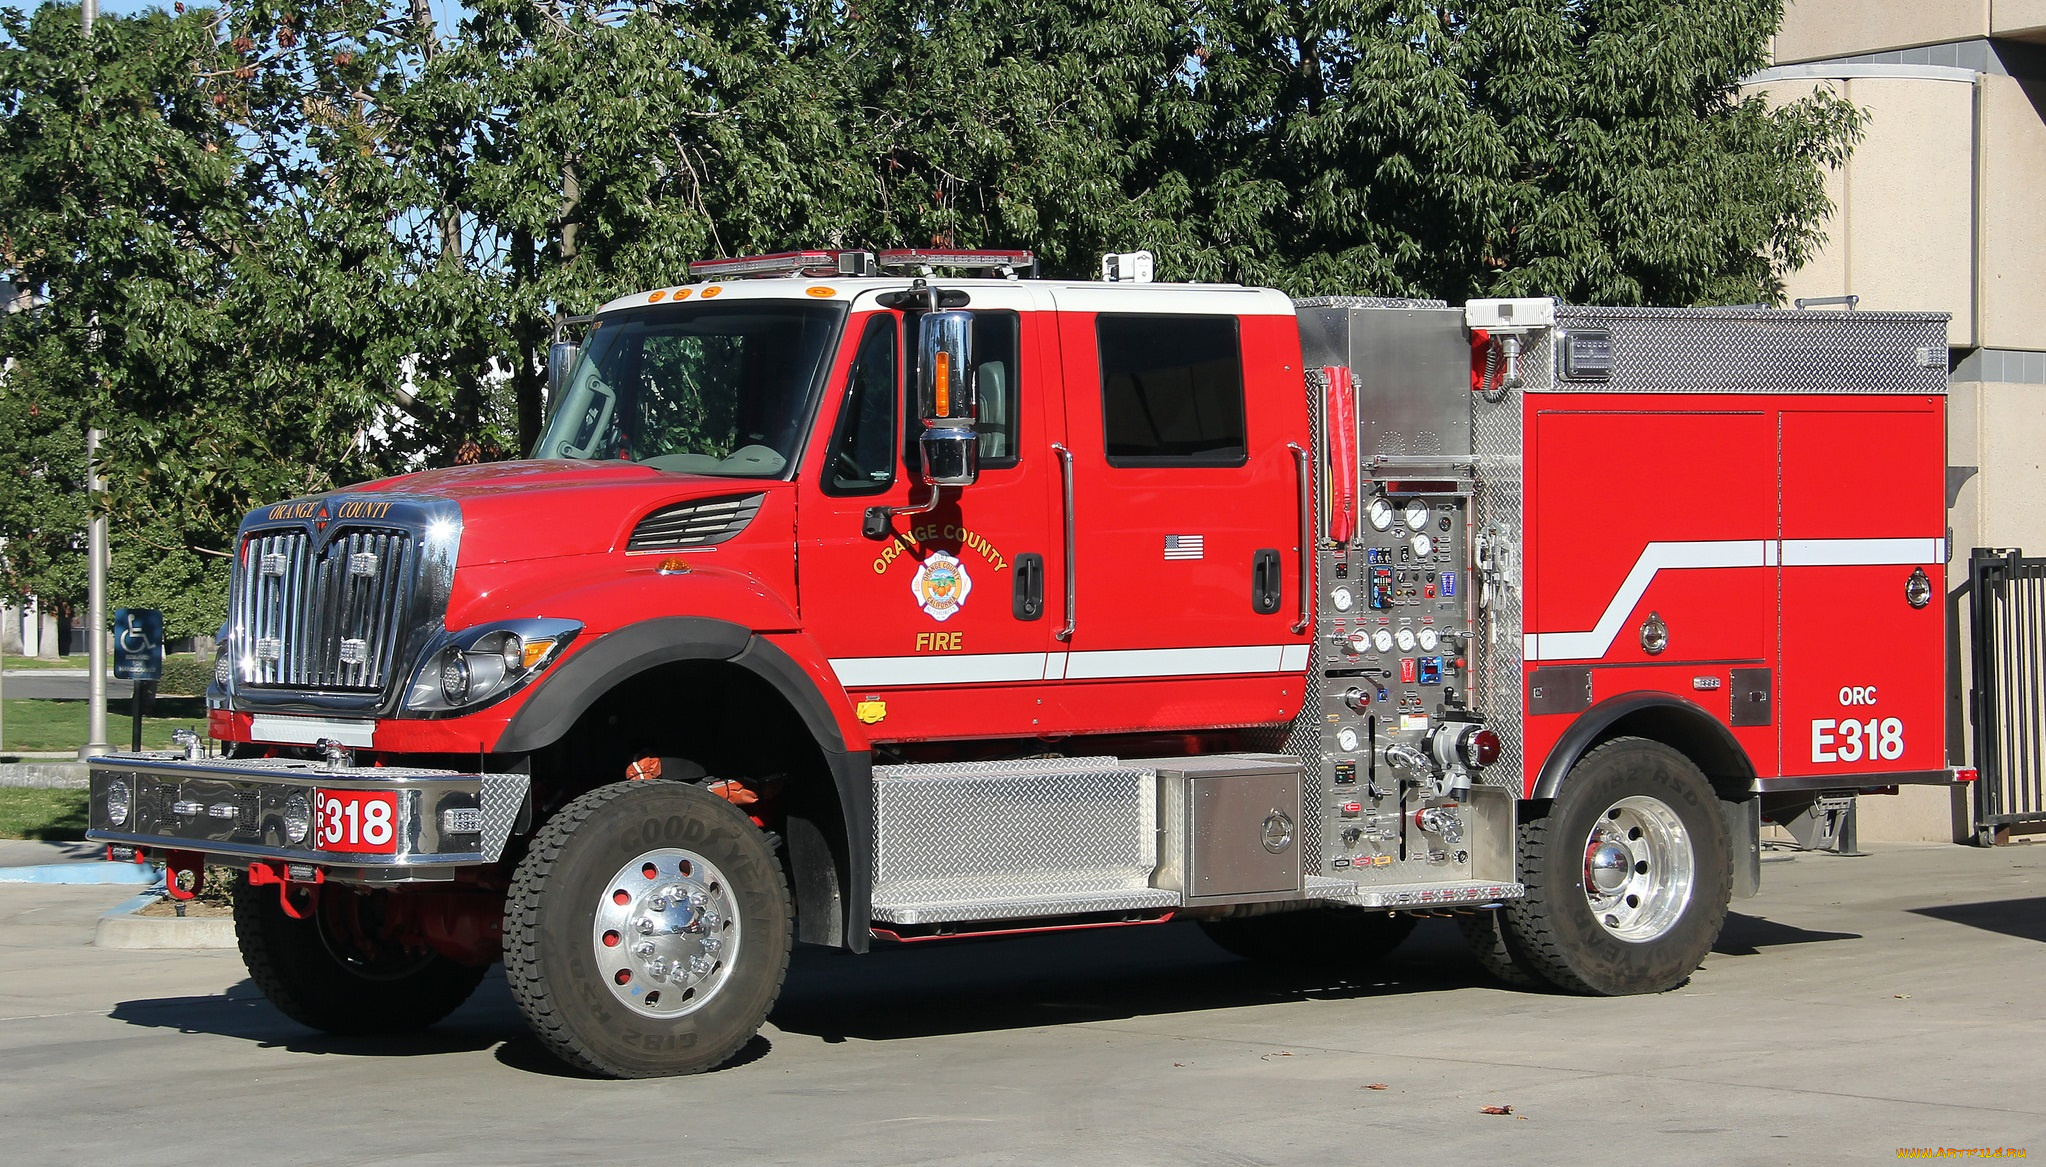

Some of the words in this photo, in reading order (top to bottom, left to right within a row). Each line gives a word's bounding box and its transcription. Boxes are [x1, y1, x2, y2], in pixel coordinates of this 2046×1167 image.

[268, 501, 319, 520] ORANGE
[338, 501, 393, 519] COUNTY
[872, 524, 937, 574] ORANGE
[943, 524, 1008, 573] COUNTY
[923, 563, 942, 581] ORANGE
[942, 562, 960, 580] COUNTY
[926, 596, 957, 609] CALIFORNIA
[915, 631, 963, 651] FIRE
[1838, 685, 1877, 706] ORC
[1811, 717, 1905, 763] E318
[317, 792, 325, 848] ORC
[325, 798, 393, 846] 318
